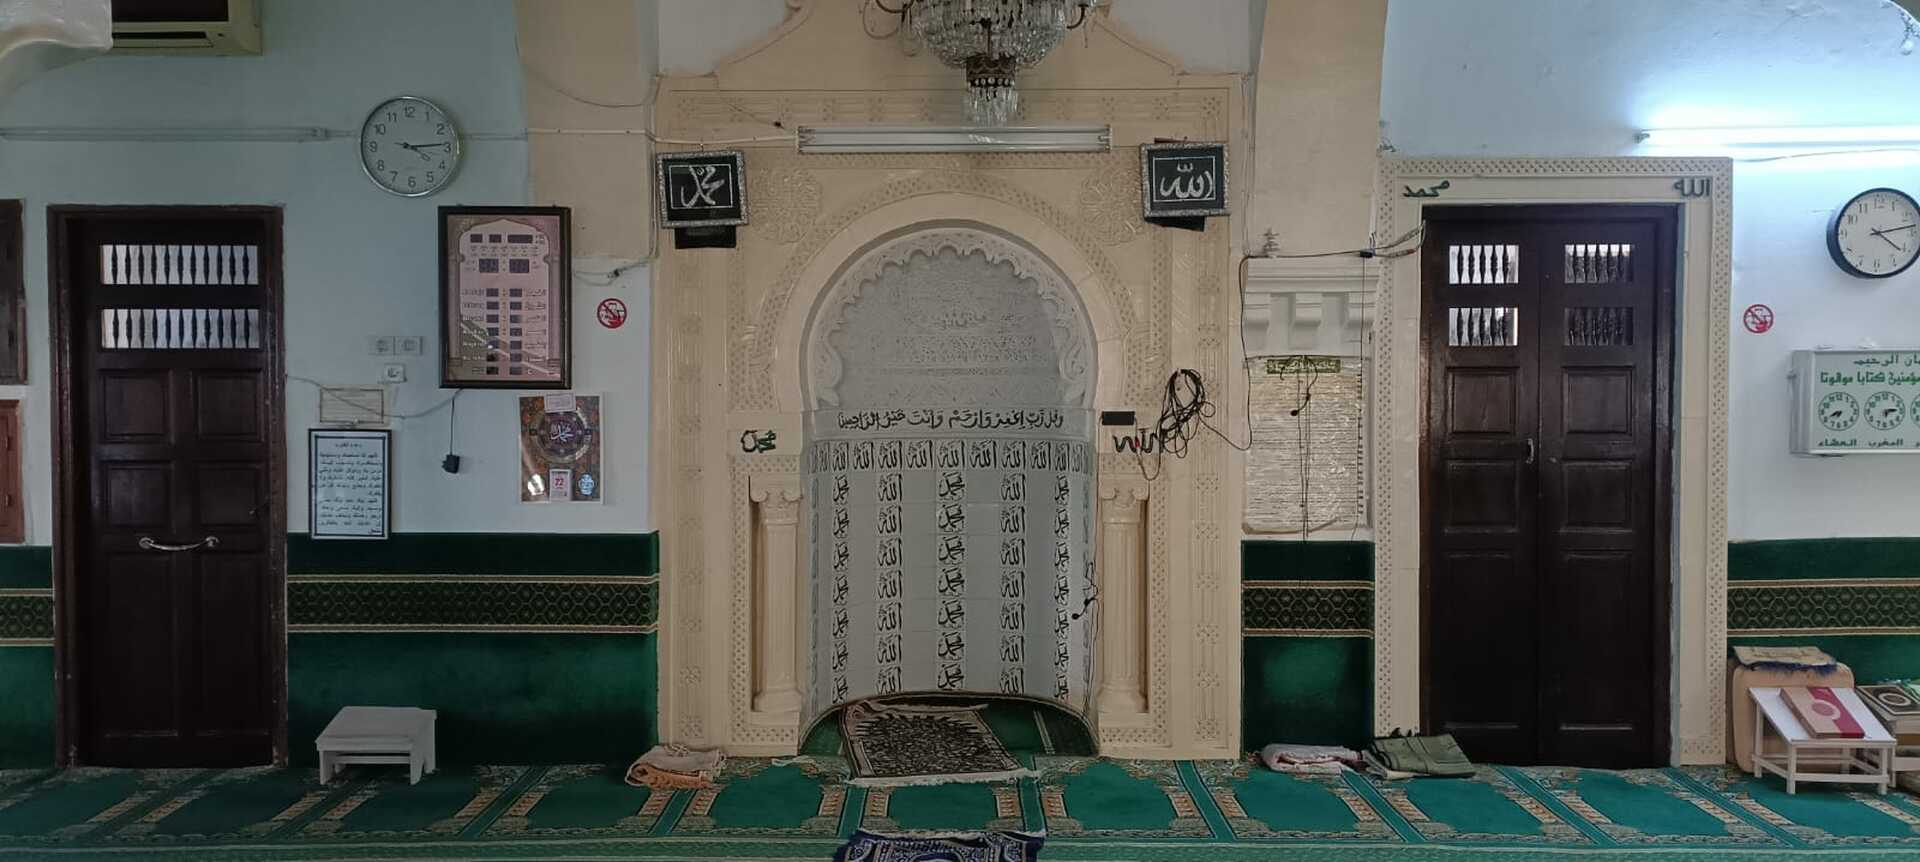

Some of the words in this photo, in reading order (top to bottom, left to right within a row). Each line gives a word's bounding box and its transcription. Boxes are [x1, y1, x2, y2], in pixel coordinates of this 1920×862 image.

[386, 112, 397, 121] 11
[404, 106, 416, 118] 12
[374, 123, 386, 135] 10
[436, 123, 445, 135] 2
[369, 141, 377, 152] 9
[443, 141, 452, 153] 3
[377, 160, 385, 171] 8
[389, 170, 398, 182] 7
[426, 171, 434, 183] 5
[407, 176, 417, 188] 6
[681, 165, 726, 208] محمد
[1160, 162, 1214, 200] الله
[1403, 180, 1450, 197] محمد
[1674, 178, 1711, 197] الله
[1847, 215, 1858, 225] 10
[1859, 203, 1868, 214] 11
[853, 441, 875, 471] الله
[877, 440, 903, 470] الله
[906, 440, 934, 470] الله
[937, 440, 965, 470] الله
[970, 440, 997, 470] الله
[1001, 440, 1026, 470] الله
[1030, 440, 1051, 470] الله
[877, 473, 903, 502] الله
[1001, 473, 1025, 502] الله
[877, 505, 903, 534] الله
[1001, 506, 1025, 535] الله
[877, 538, 903, 567] الله
[1001, 538, 1025, 567] الله
[877, 570, 903, 599] الله
[1001, 570, 1025, 599] الله
[877, 602, 903, 631] الله
[1001, 602, 1025, 631] الله
[877, 635, 903, 663] الله
[1001, 635, 1025, 664] الله
[877, 667, 903, 696] الله
[1001, 667, 1025, 696] الله
